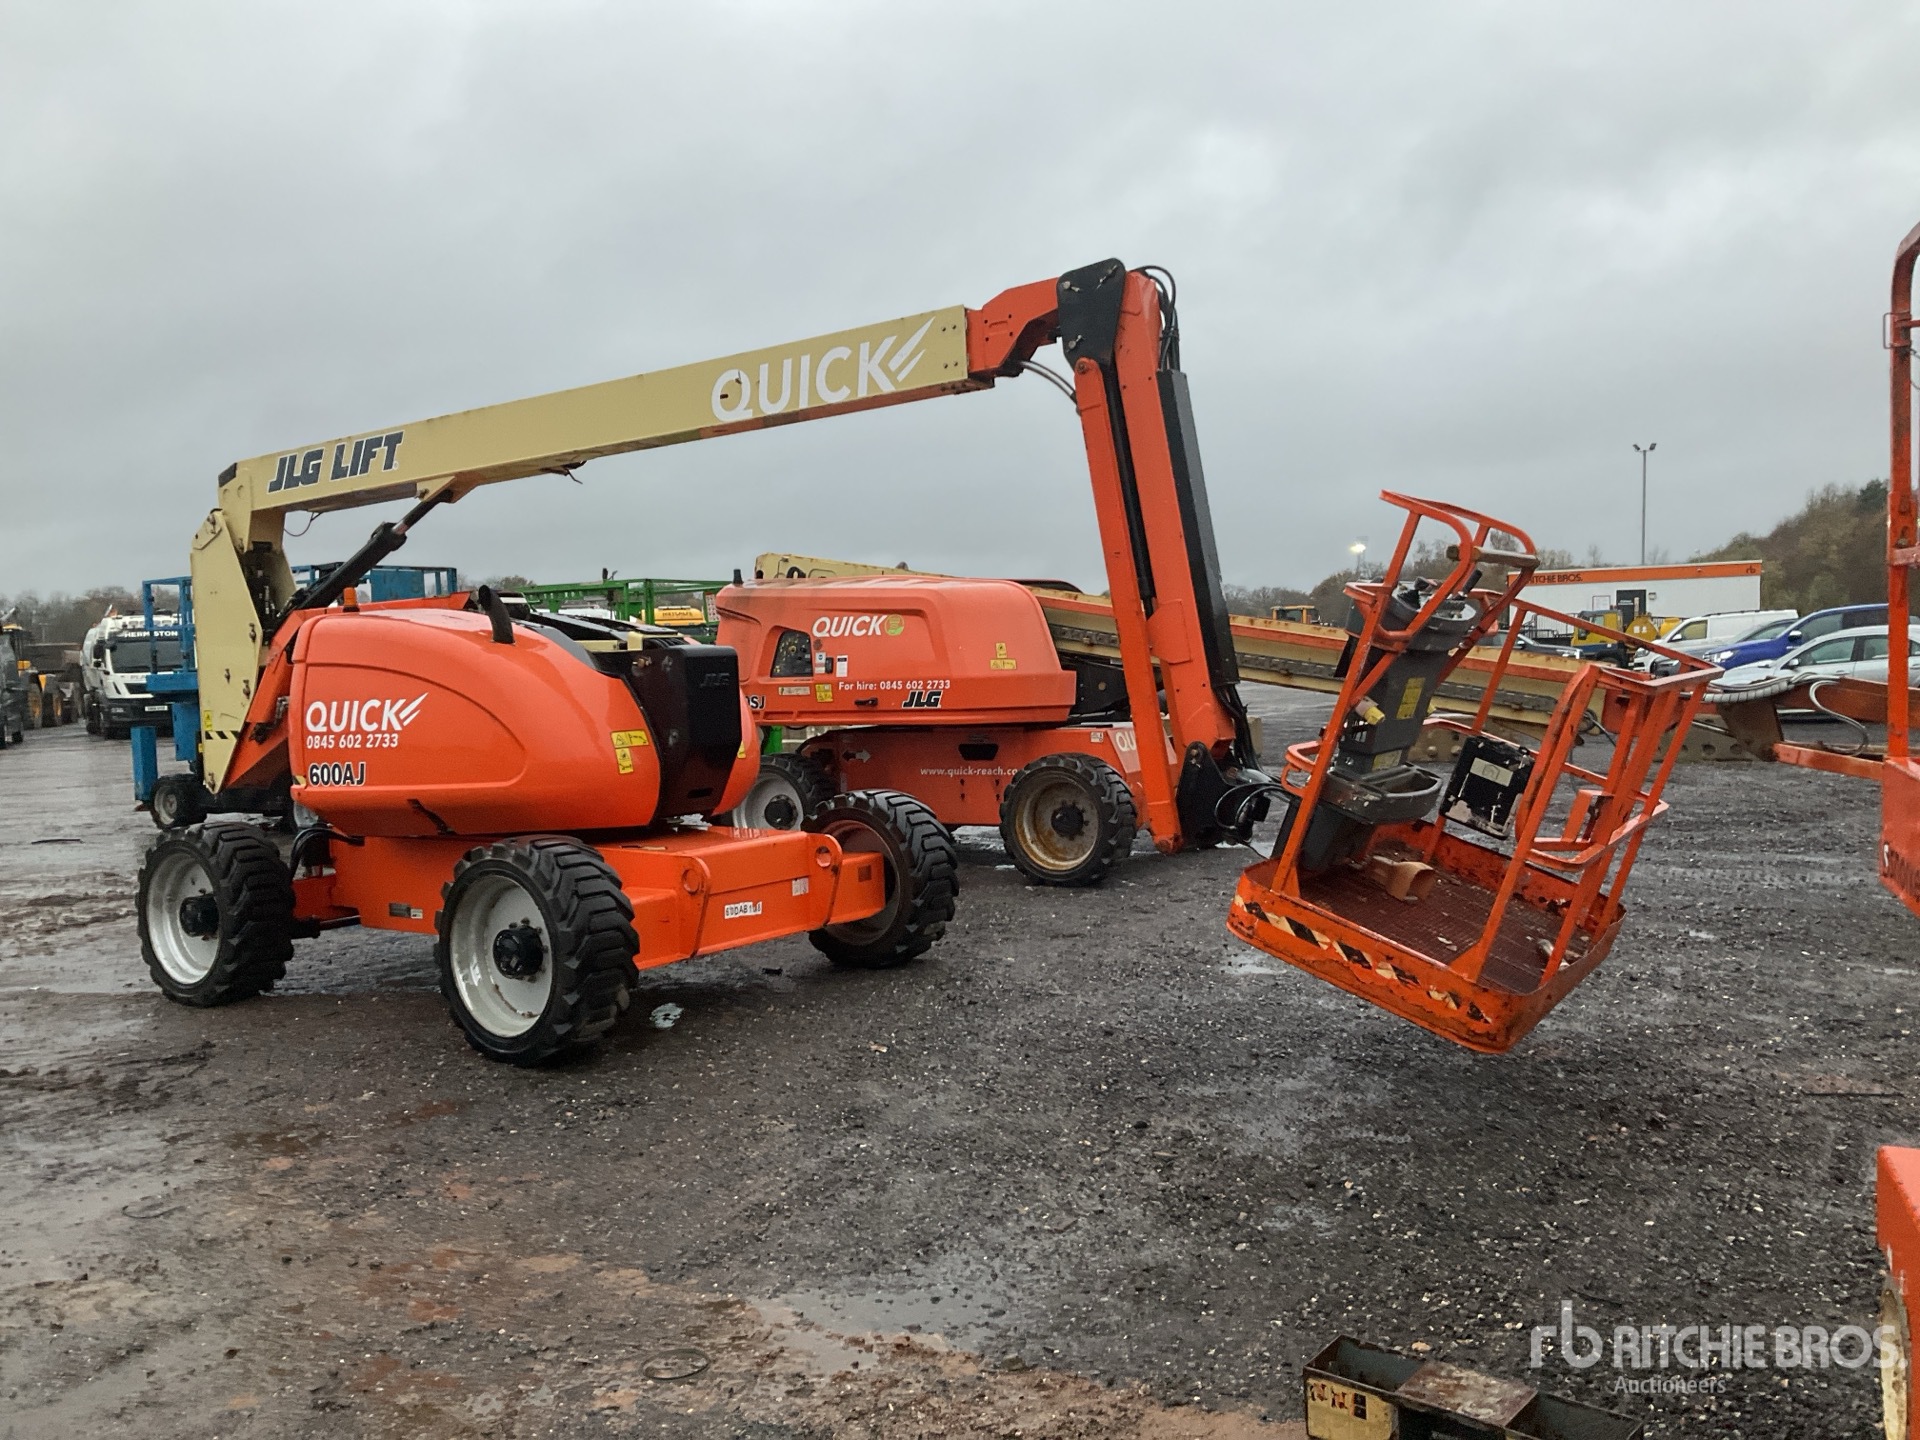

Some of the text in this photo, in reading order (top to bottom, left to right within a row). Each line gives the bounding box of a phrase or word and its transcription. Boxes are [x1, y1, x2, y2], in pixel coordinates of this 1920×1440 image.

[711, 335, 897, 422] QUICK
[267, 430, 404, 494] JLG LIFT
[124, 629, 179, 638] HERMSTON
[811, 614, 888, 638] QUICK
[838, 679, 951, 691] For hire: 0845 602 2733
[902, 689, 943, 709] JLG
[305, 698, 407, 733] QUICK
[306, 733, 399, 750] 0845 602 2733
[308, 761, 367, 788] 600AJ
